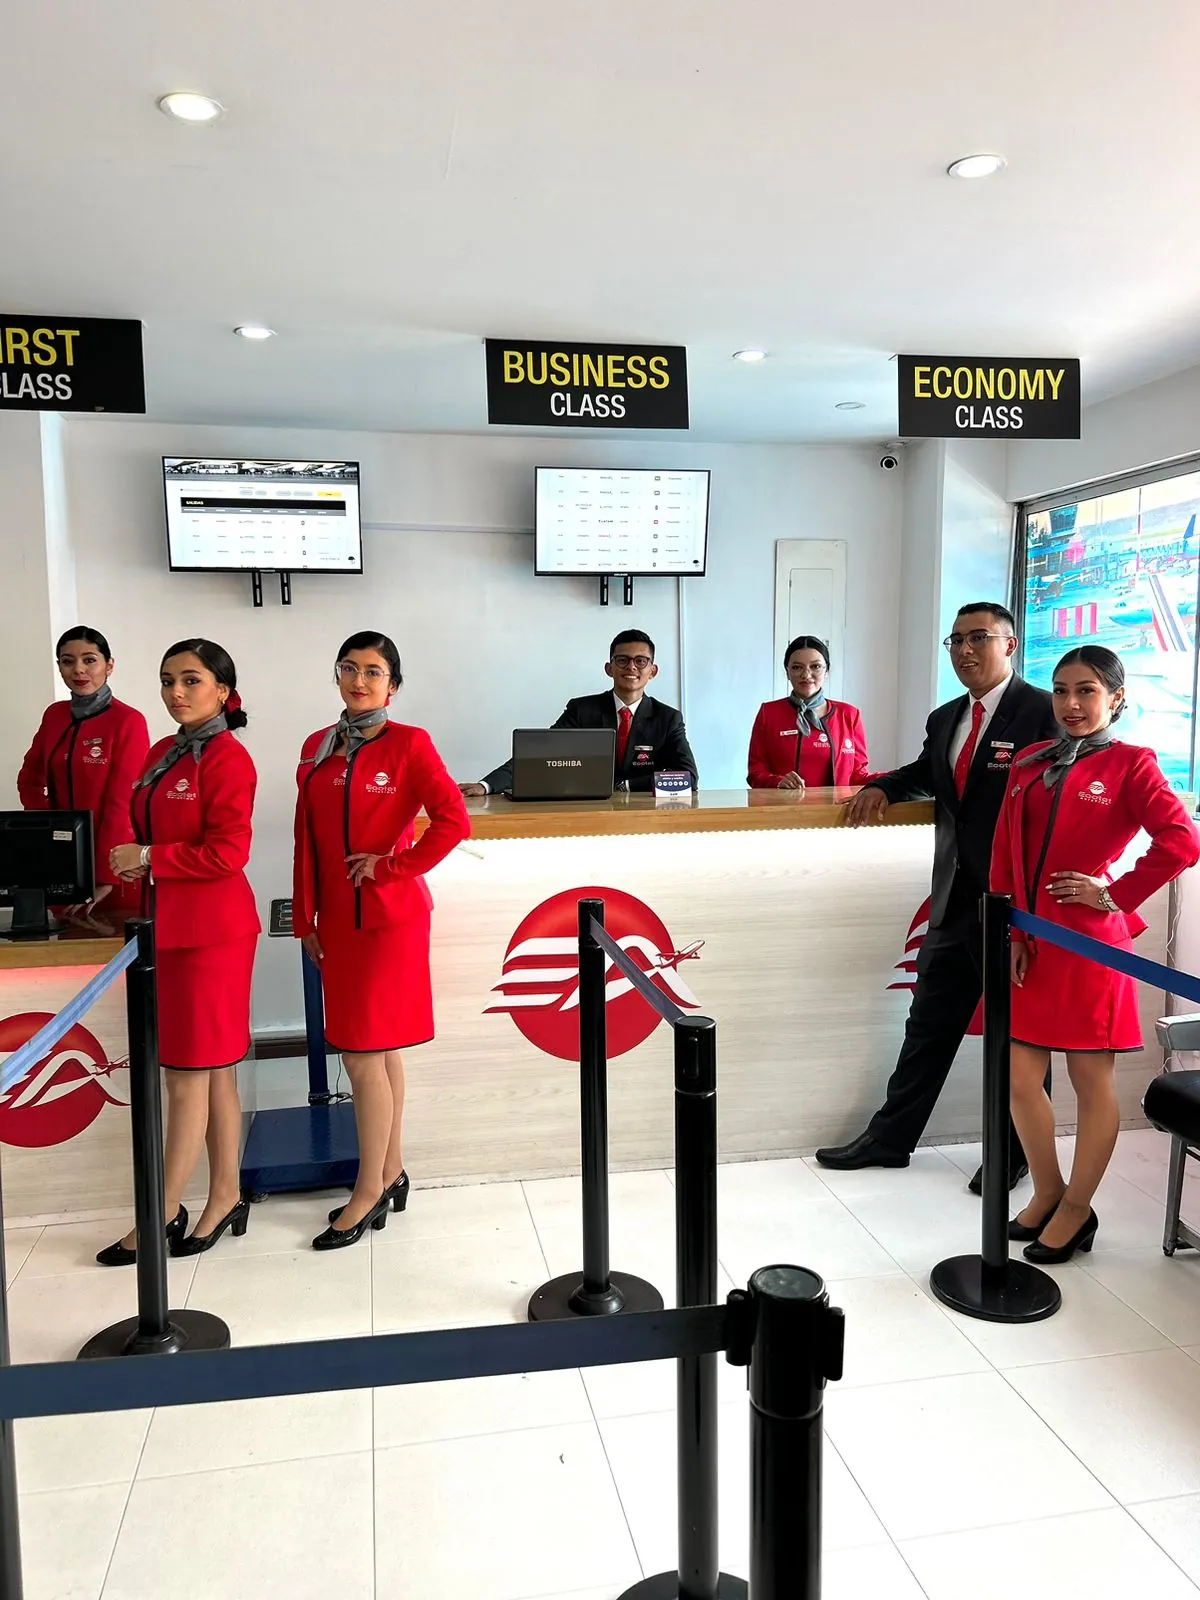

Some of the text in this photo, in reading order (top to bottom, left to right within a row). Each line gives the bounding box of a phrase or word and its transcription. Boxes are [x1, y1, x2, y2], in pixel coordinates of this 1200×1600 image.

[503, 350, 670, 389] BUSINESS
[914, 366, 1065, 400] ECONOMY
[0, 372, 72, 400] LASS
[550, 392, 626, 418] CLASS
[955, 405, 1023, 429] CLASS
